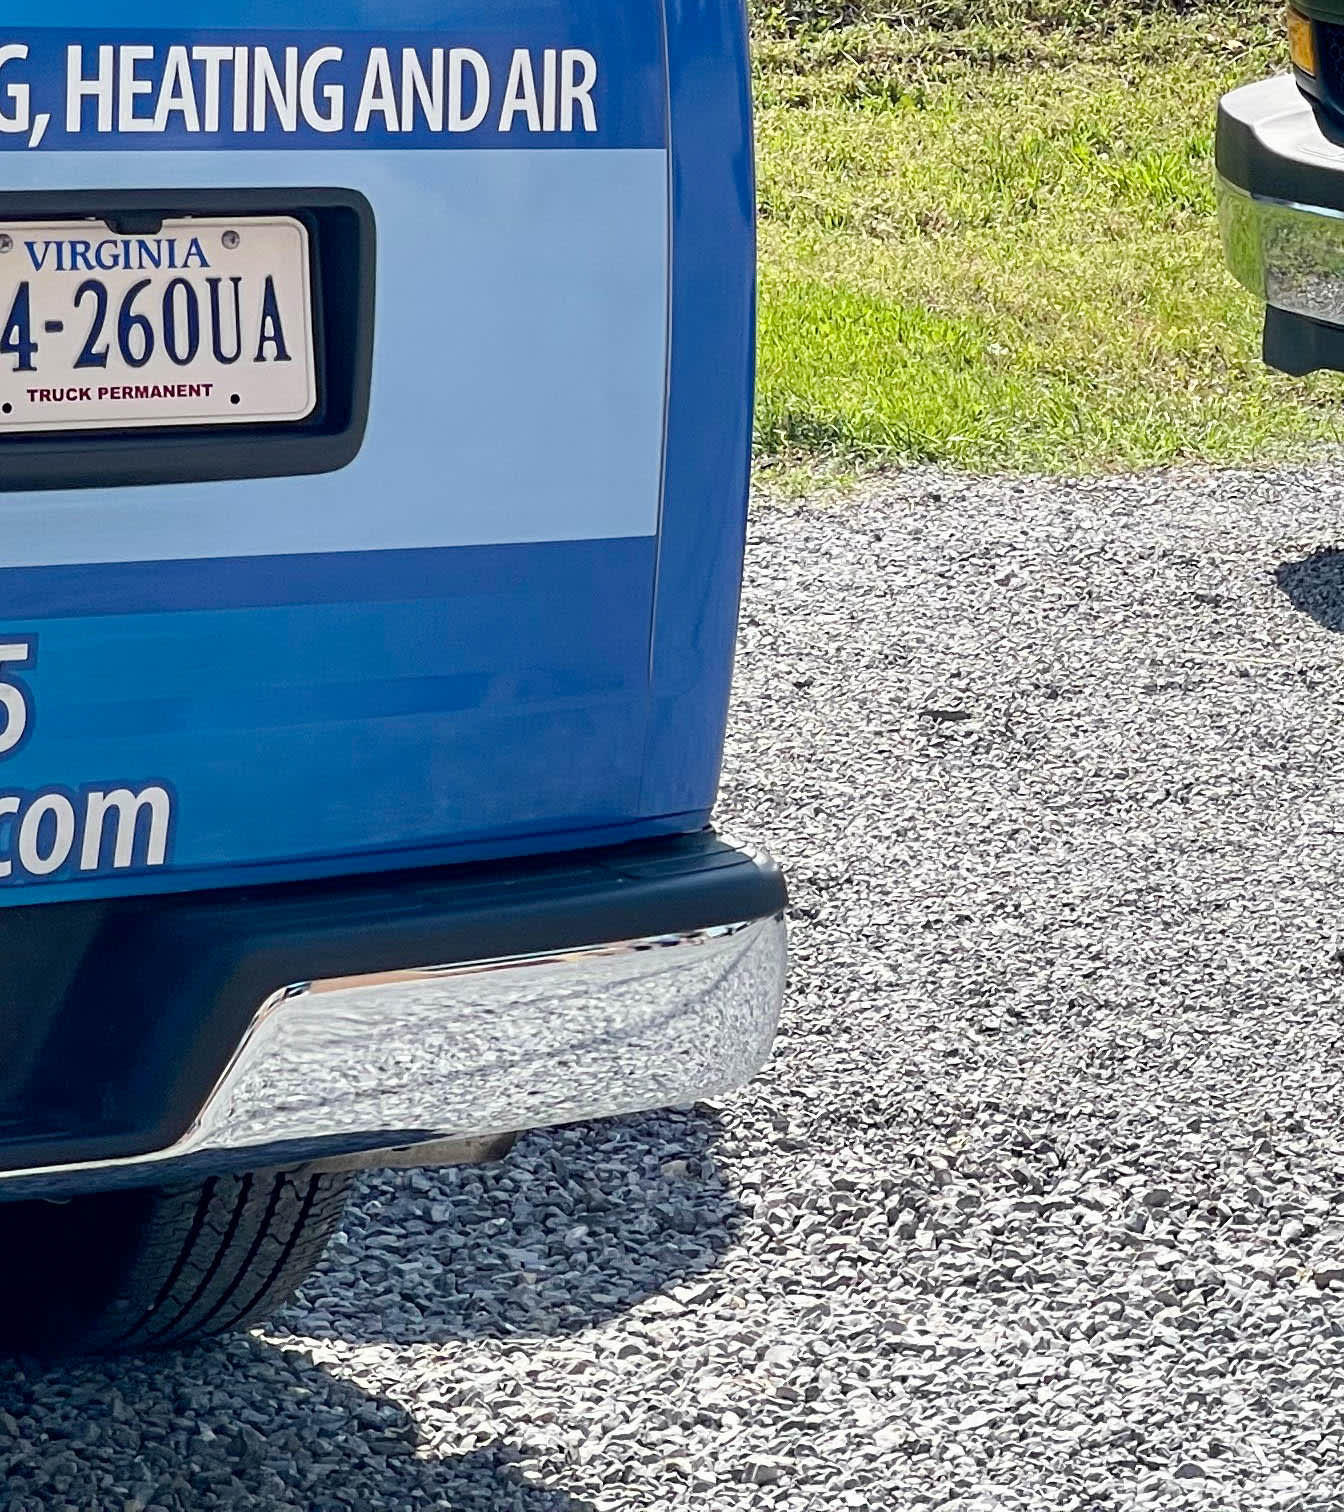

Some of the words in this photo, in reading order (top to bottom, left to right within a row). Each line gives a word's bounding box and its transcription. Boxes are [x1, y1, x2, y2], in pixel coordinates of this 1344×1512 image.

[66, 45, 343, 133] HEATING
[354, 47, 490, 132] AND
[498, 48, 598, 132] AIR
[24, 237, 210, 272] VIRGINIA
[0, 274, 292, 372] 4-260UA
[26, 387, 92, 403] TRUCK
[98, 383, 213, 401] PERMANENT
